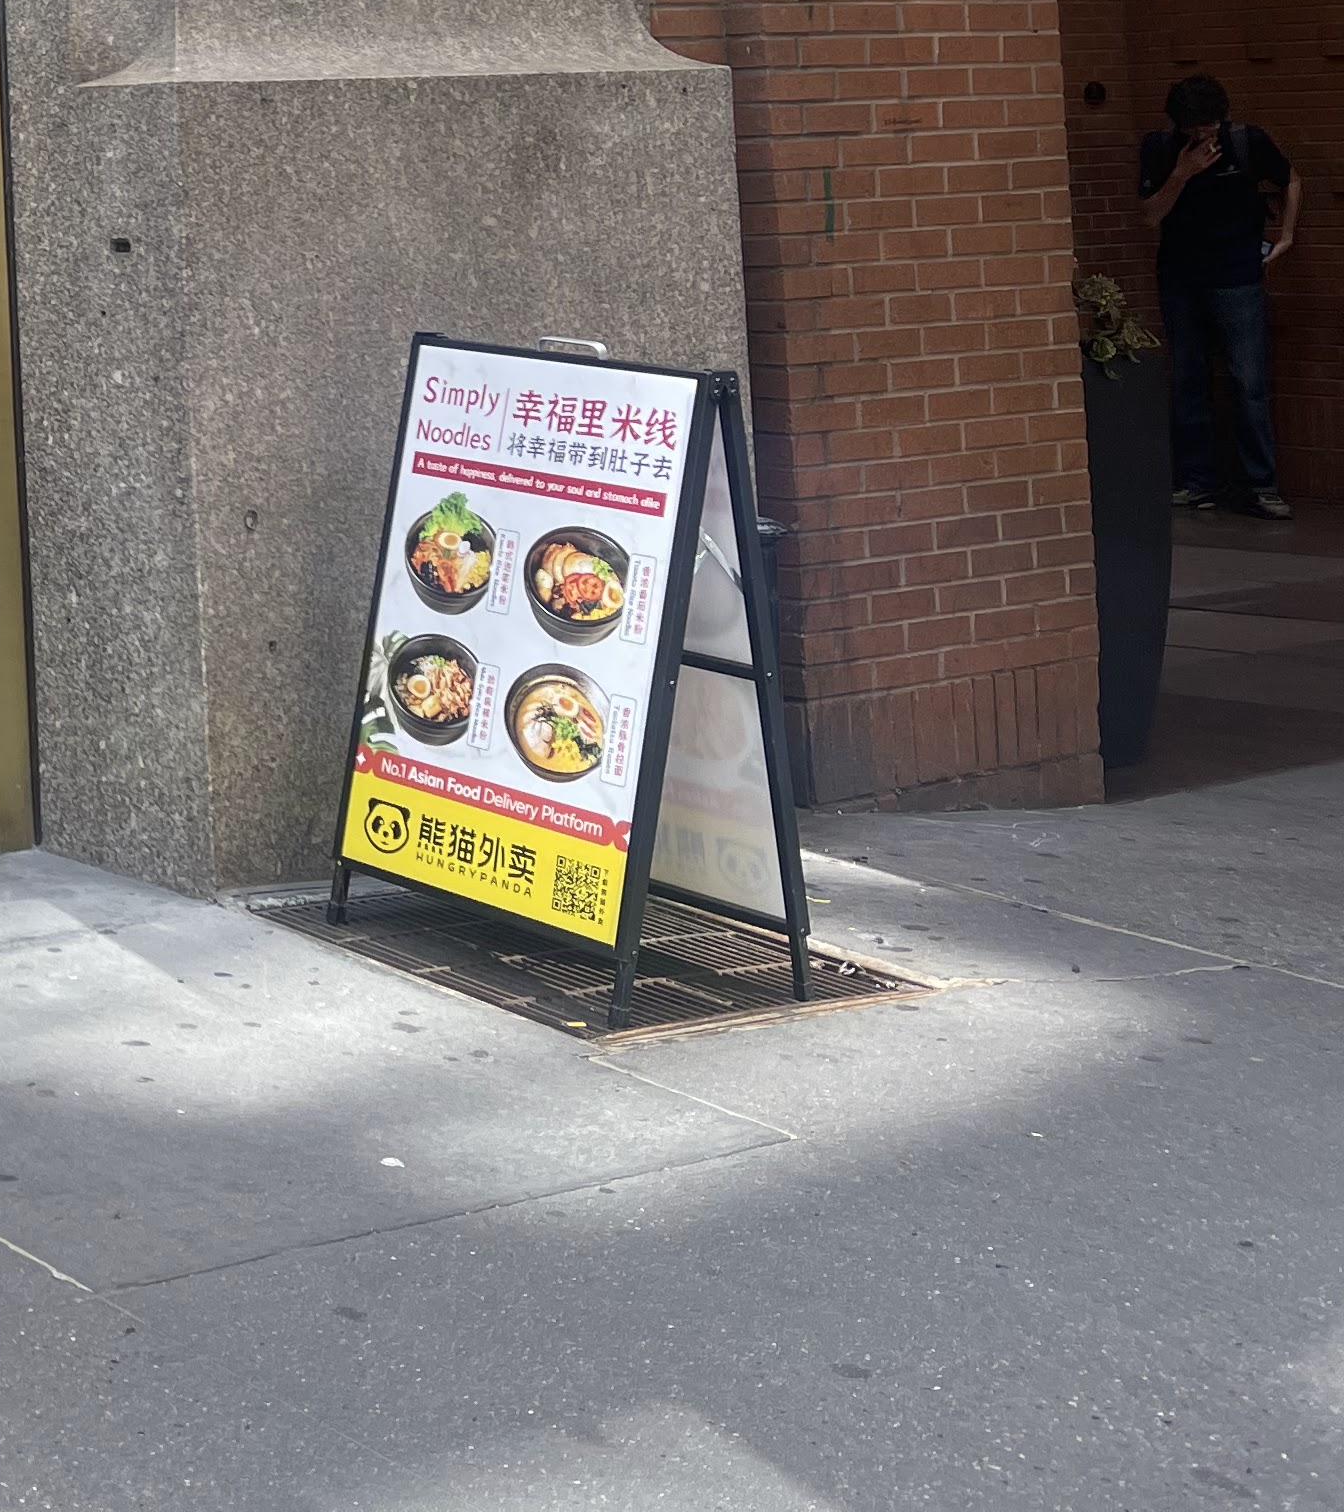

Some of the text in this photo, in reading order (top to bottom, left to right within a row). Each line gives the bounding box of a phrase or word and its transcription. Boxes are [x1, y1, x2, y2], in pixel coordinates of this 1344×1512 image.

[422, 375, 501, 419] Simply
[511, 388, 679, 450] 幸福里米线
[415, 418, 493, 452] Noodles
[506, 431, 674, 481] 将幸福带到肚子去
[535, 478, 545, 489] to
[381, 757, 604, 837] No.1 Asian Food Delivery Platform
[417, 813, 538, 886] 熊猫外卖
[415, 852, 534, 898] HUNGRYPANDA
